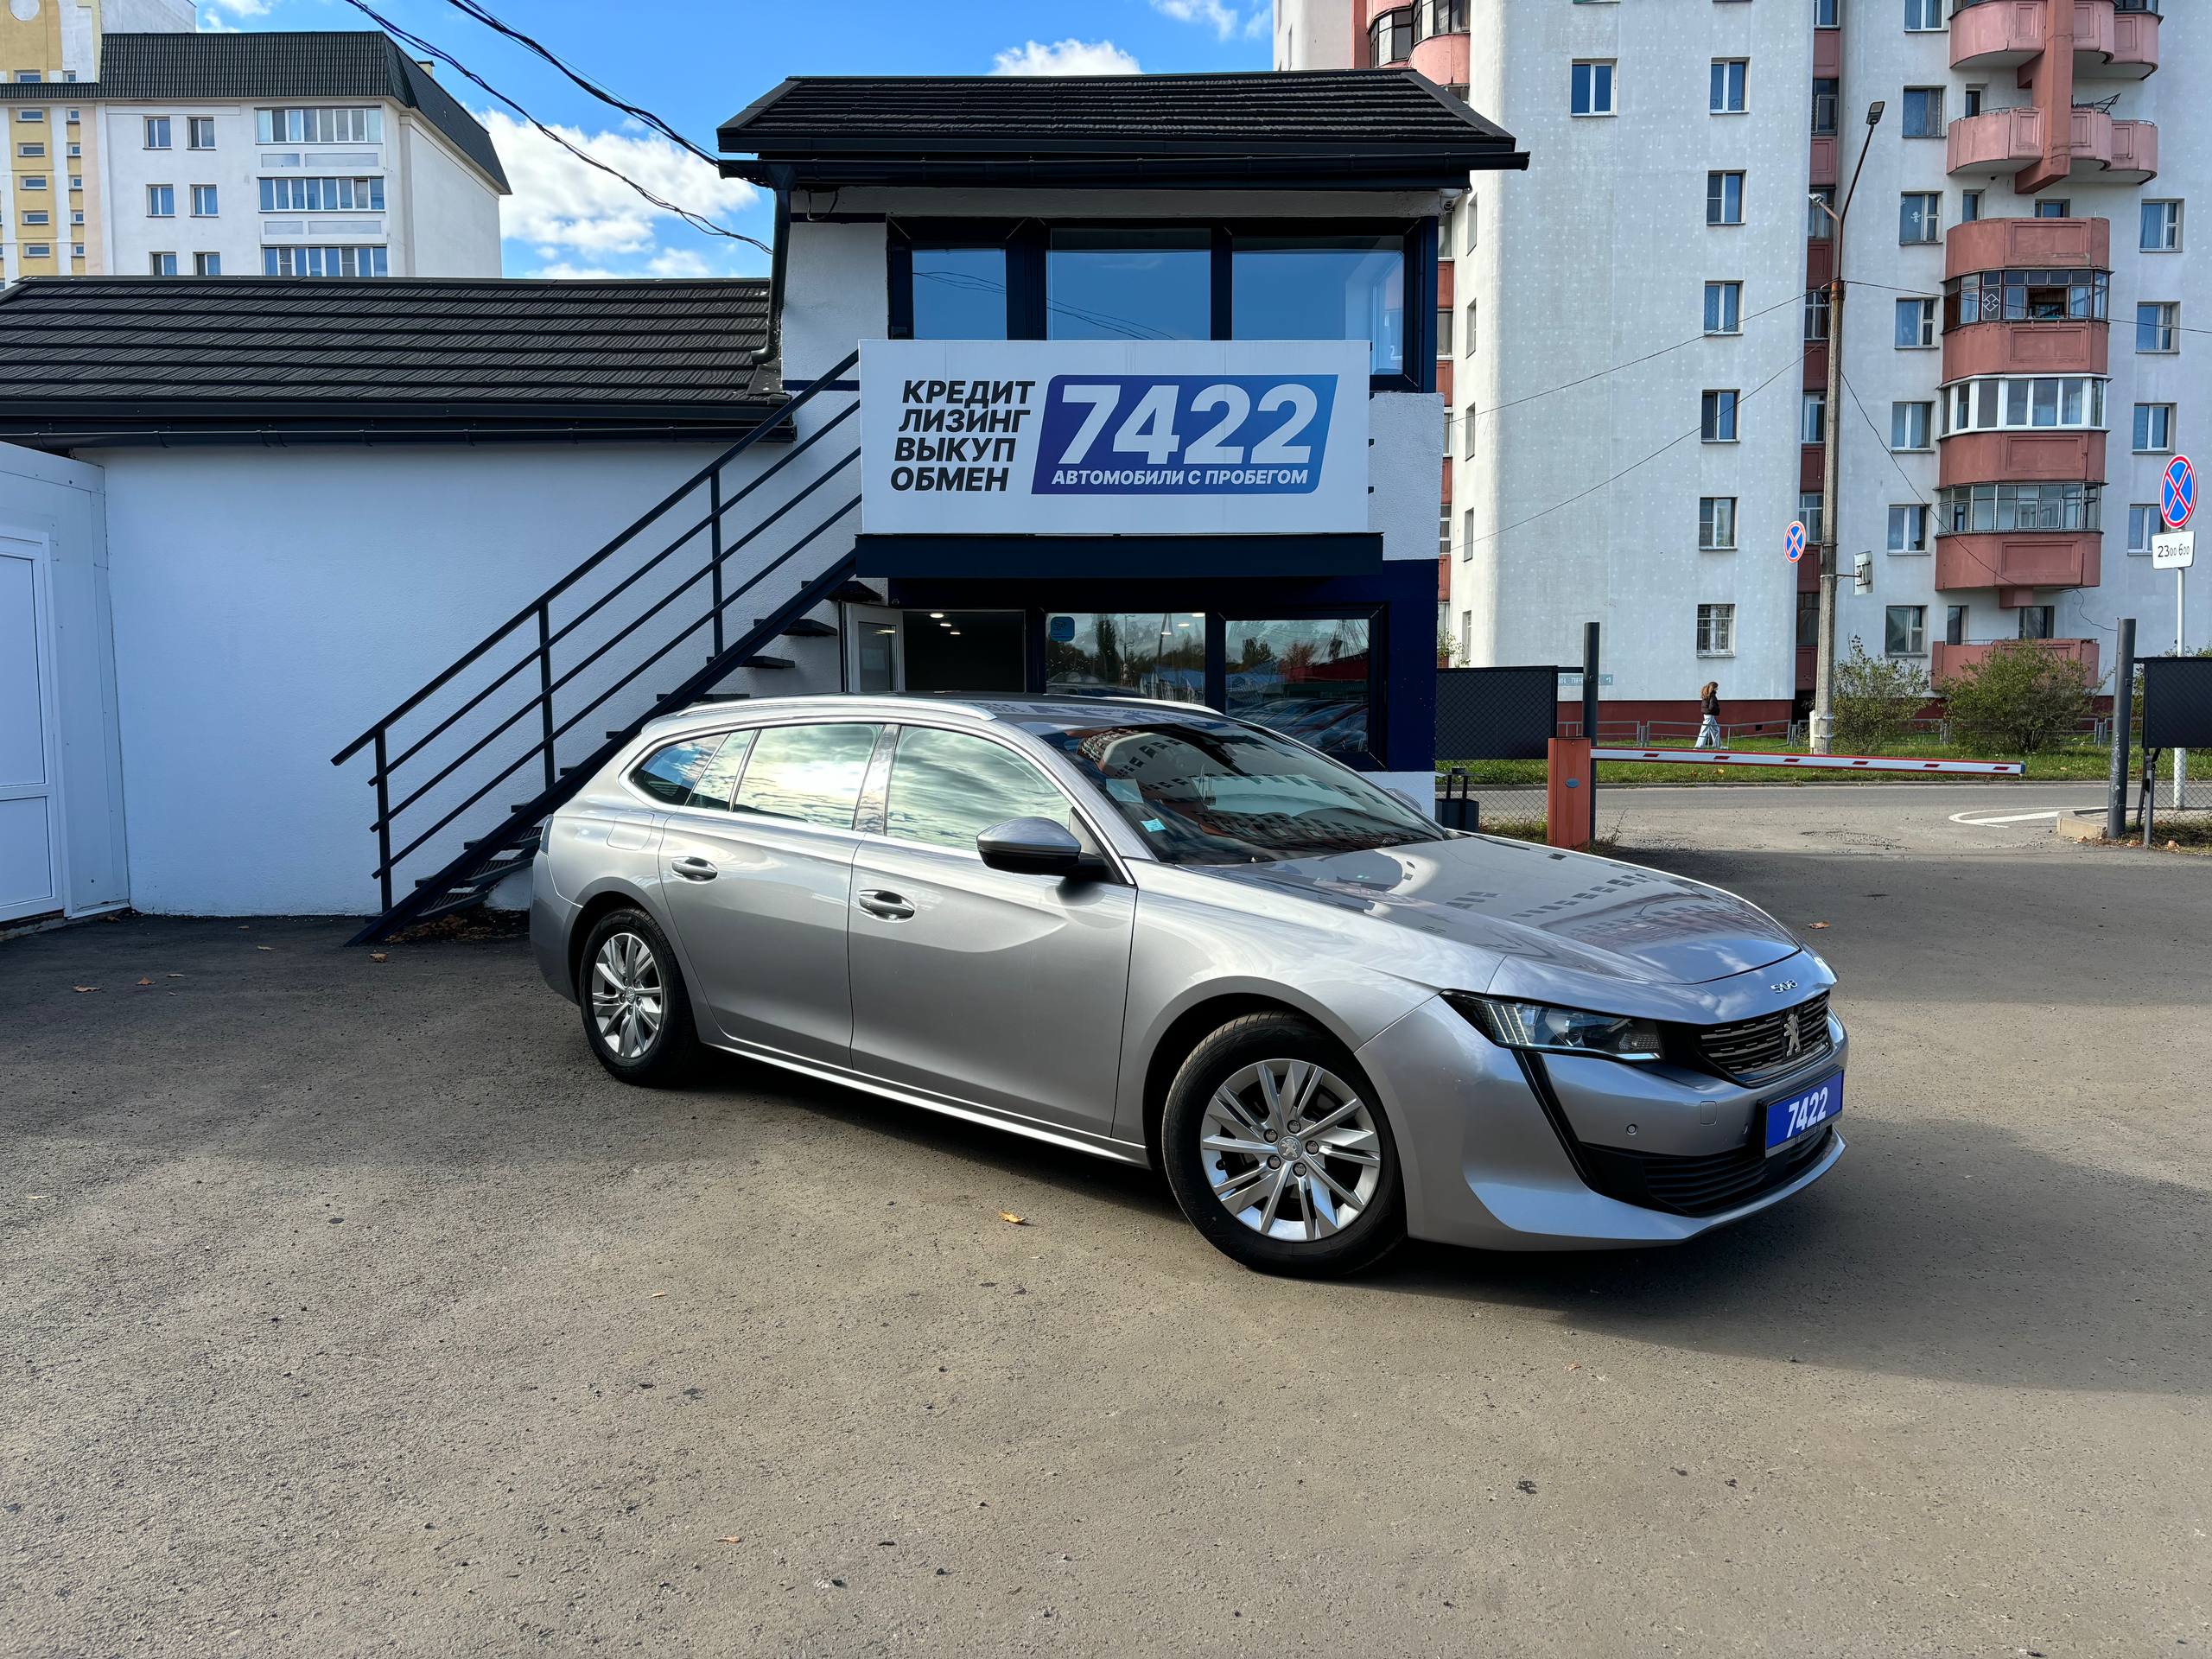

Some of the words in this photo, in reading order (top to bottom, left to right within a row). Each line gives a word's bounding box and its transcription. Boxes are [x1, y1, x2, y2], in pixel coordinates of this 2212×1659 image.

[902, 380, 1036, 409] КРЕДИТ
[898, 409, 1031, 433] ЛИЗИНГ
[1058, 383, 1318, 465] 7422
[894, 437, 1016, 462] ВЫКУП
[890, 467, 1009, 492] ОБМЕН
[1052, 470, 1185, 485] АВТОМОБИЛИ
[1187, 470, 1202, 485] С
[1205, 469, 1309, 485] ПРОБЕГОМ
[1786, 1086, 1828, 1139] 7422
